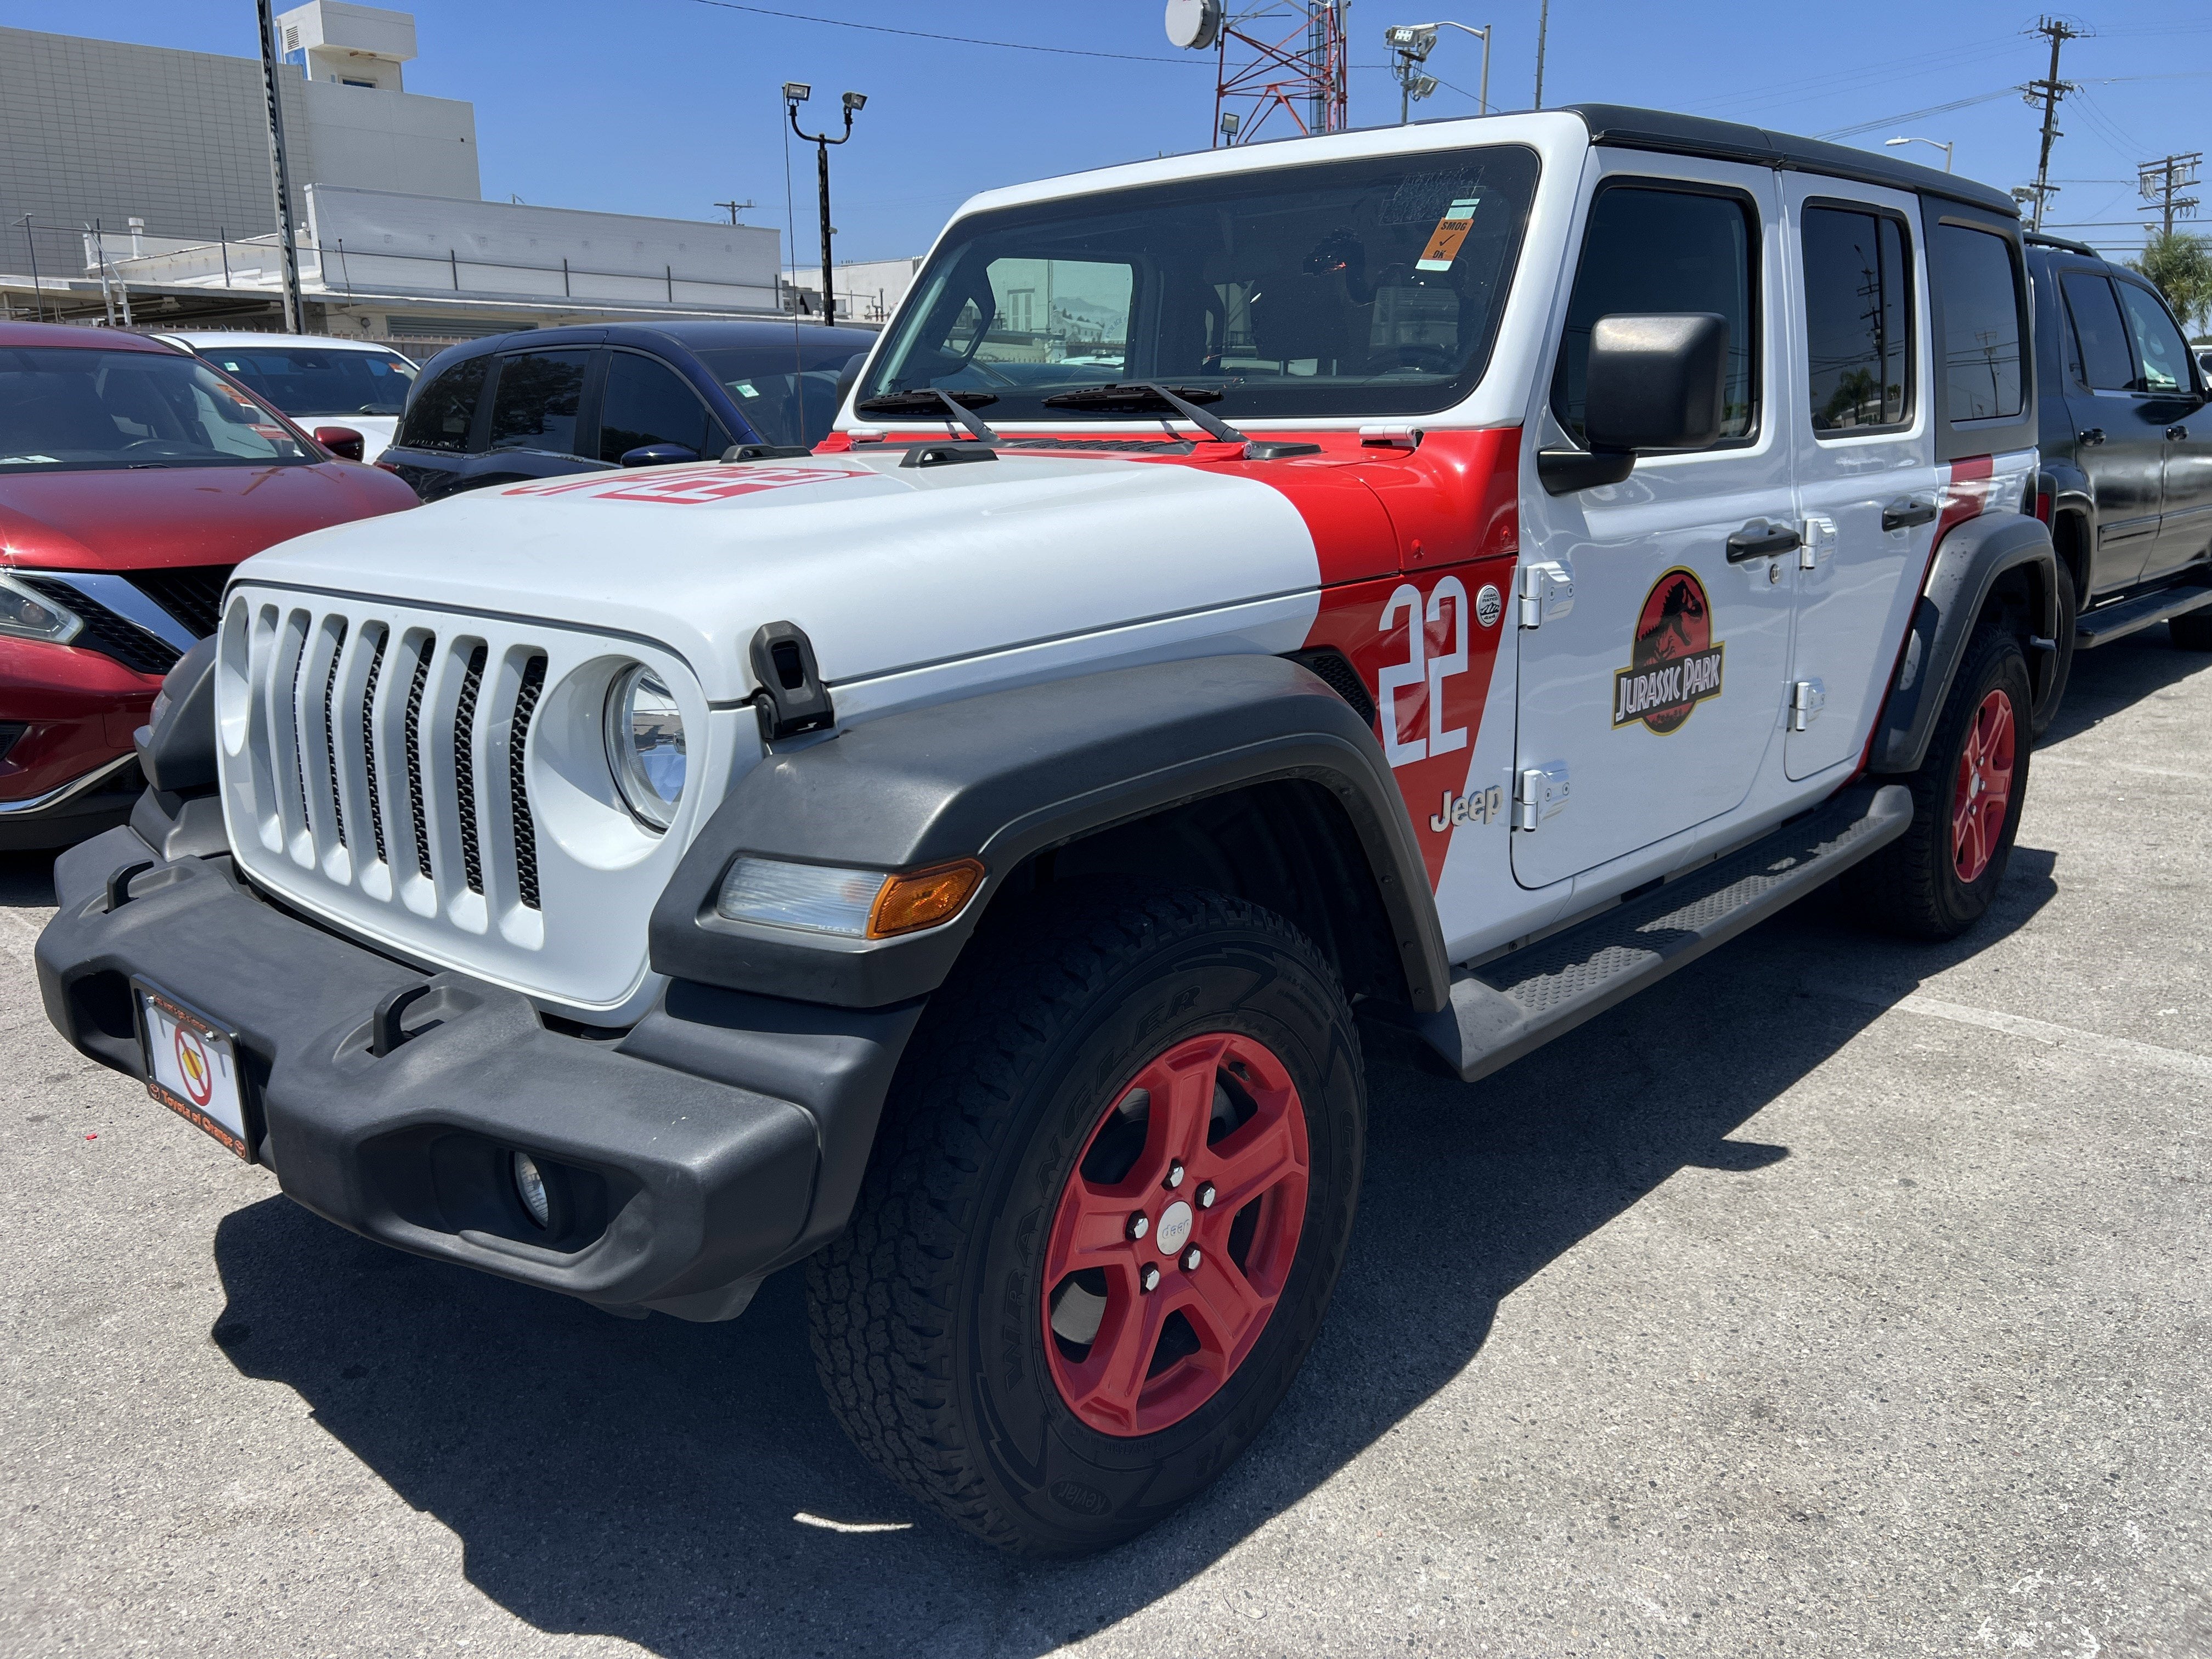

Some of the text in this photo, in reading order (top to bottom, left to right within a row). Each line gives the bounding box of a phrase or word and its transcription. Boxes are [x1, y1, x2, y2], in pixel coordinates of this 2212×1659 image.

[1441, 222, 1468, 231] SMOG
[1432, 250, 1447, 259] OK
[1379, 575, 1469, 769] 22
[1615, 653, 1721, 723] JURASSIC PARK
[1430, 785, 1504, 833] Jeep
[161, 1089, 191, 1119] Toyota
[192, 1113, 202, 1125] of
[1162, 1218, 1190, 1239] Jeep
[1059, 1481, 1107, 1515] Kevlar
